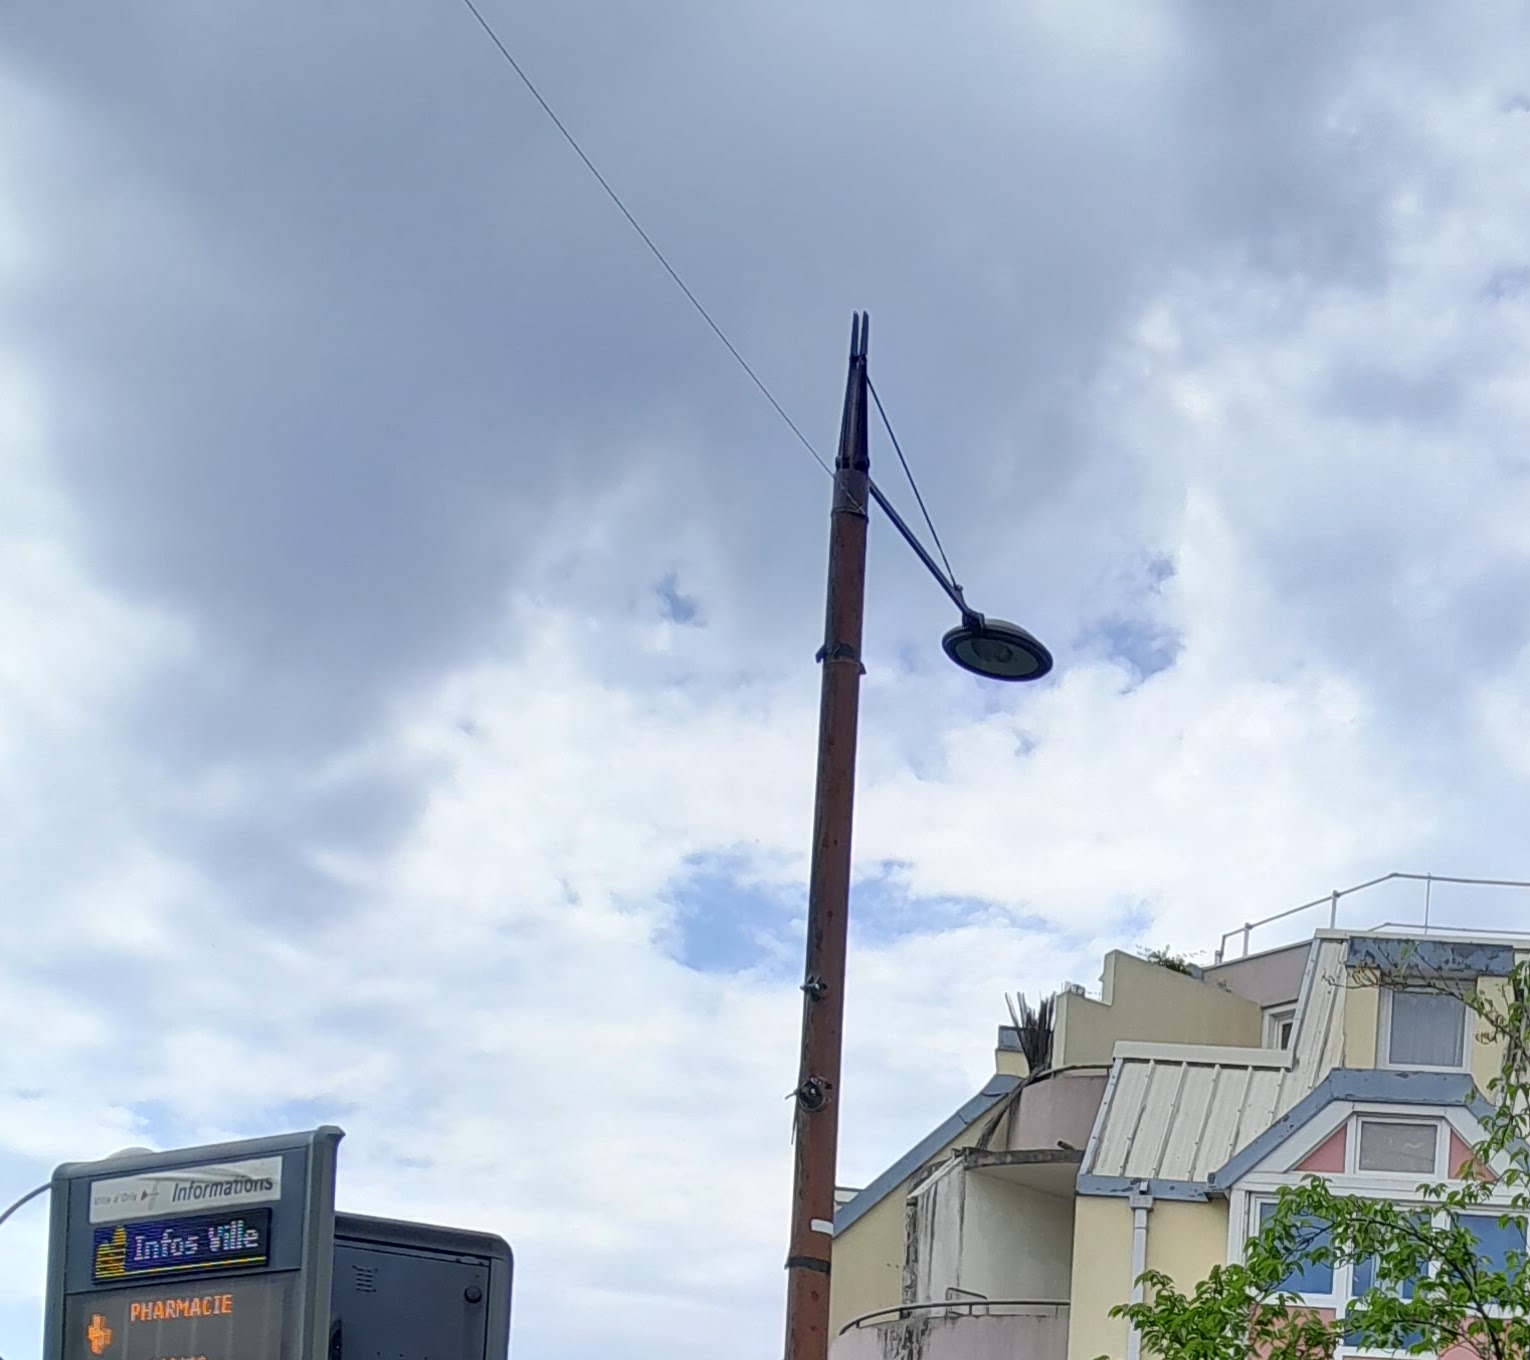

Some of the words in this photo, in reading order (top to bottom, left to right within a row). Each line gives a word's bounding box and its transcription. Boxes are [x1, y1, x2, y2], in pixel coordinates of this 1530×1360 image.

[172, 1177, 273, 1202] Informations
[134, 1228, 199, 1261] Infos
[208, 1219, 259, 1252] Ville
[130, 1294, 233, 1323] PHARMACIE
